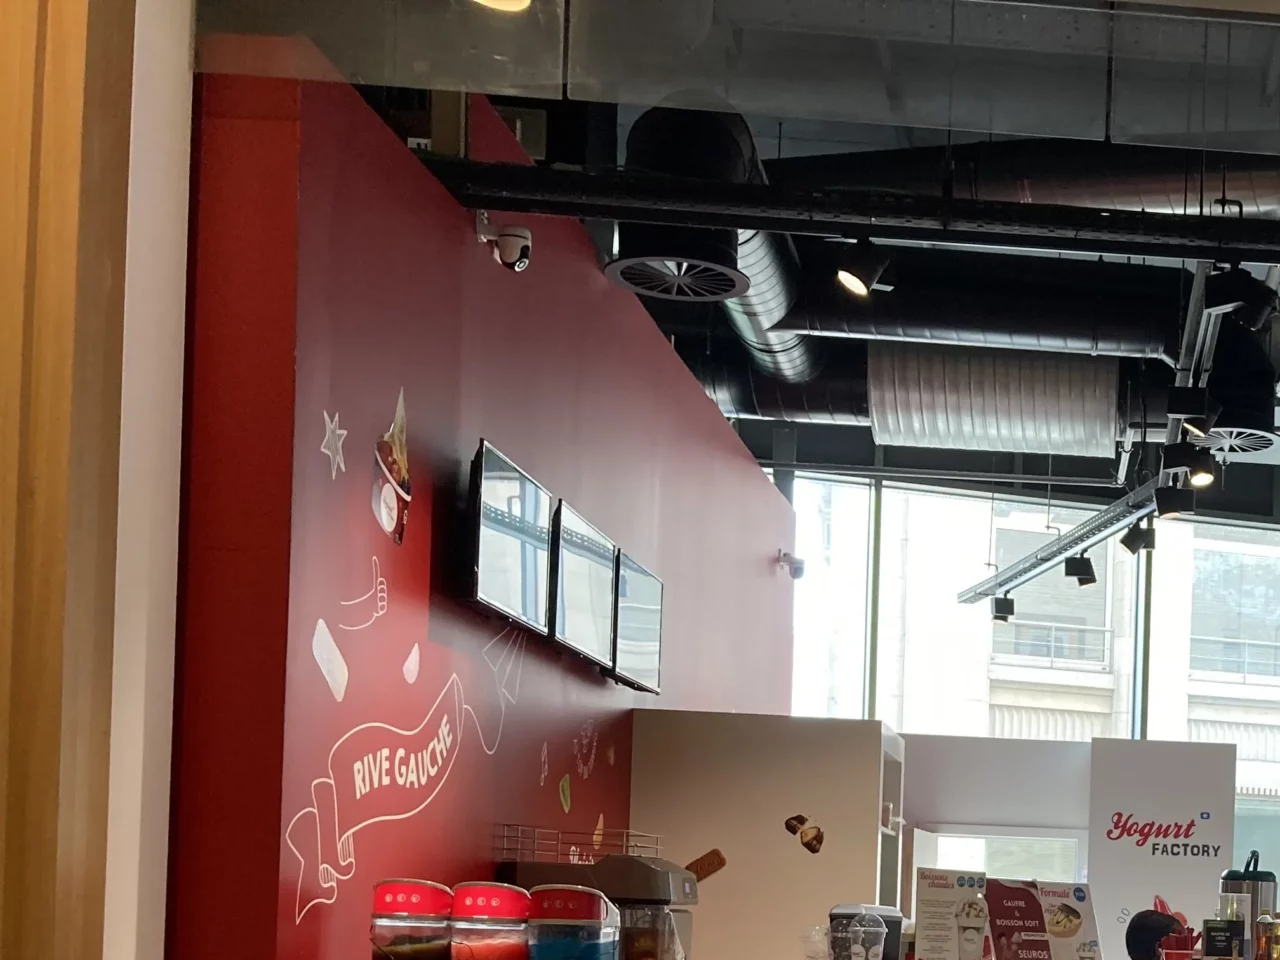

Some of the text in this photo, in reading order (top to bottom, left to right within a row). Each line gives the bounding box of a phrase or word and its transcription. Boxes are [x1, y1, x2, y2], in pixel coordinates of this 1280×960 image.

[353, 713, 453, 800] RIVE GAUCHE
[1106, 811, 1196, 847] Yogurt
[1151, 842, 1221, 857] FACTORY
[995, 918, 1024, 927] BOISSON
